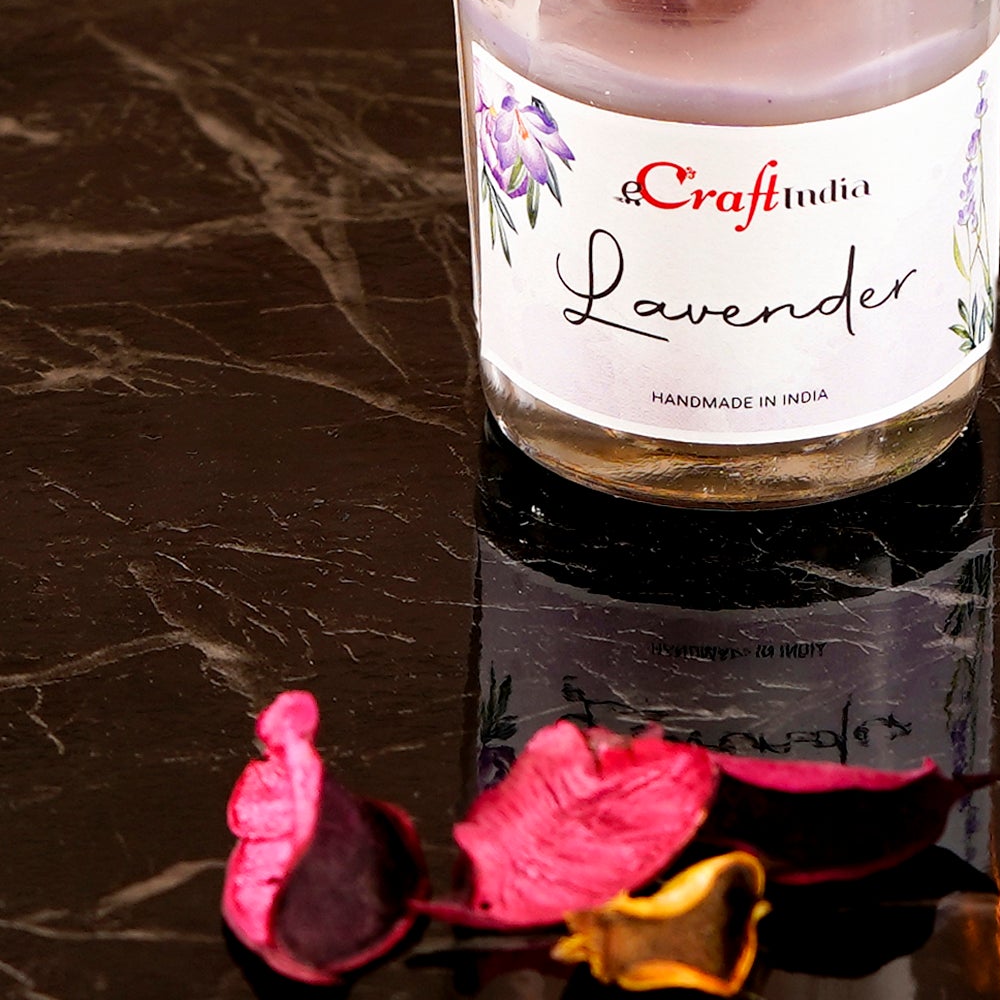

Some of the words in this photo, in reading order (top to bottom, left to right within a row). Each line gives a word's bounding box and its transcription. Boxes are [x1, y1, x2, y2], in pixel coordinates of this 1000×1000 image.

[616, 160, 870, 232] eCraftIndia
[556, 228, 918, 342] Lavender
[651, 390, 754, 410] HANDMADE
[759, 395, 777, 408] IN
[782, 388, 829, 406] INDIA
